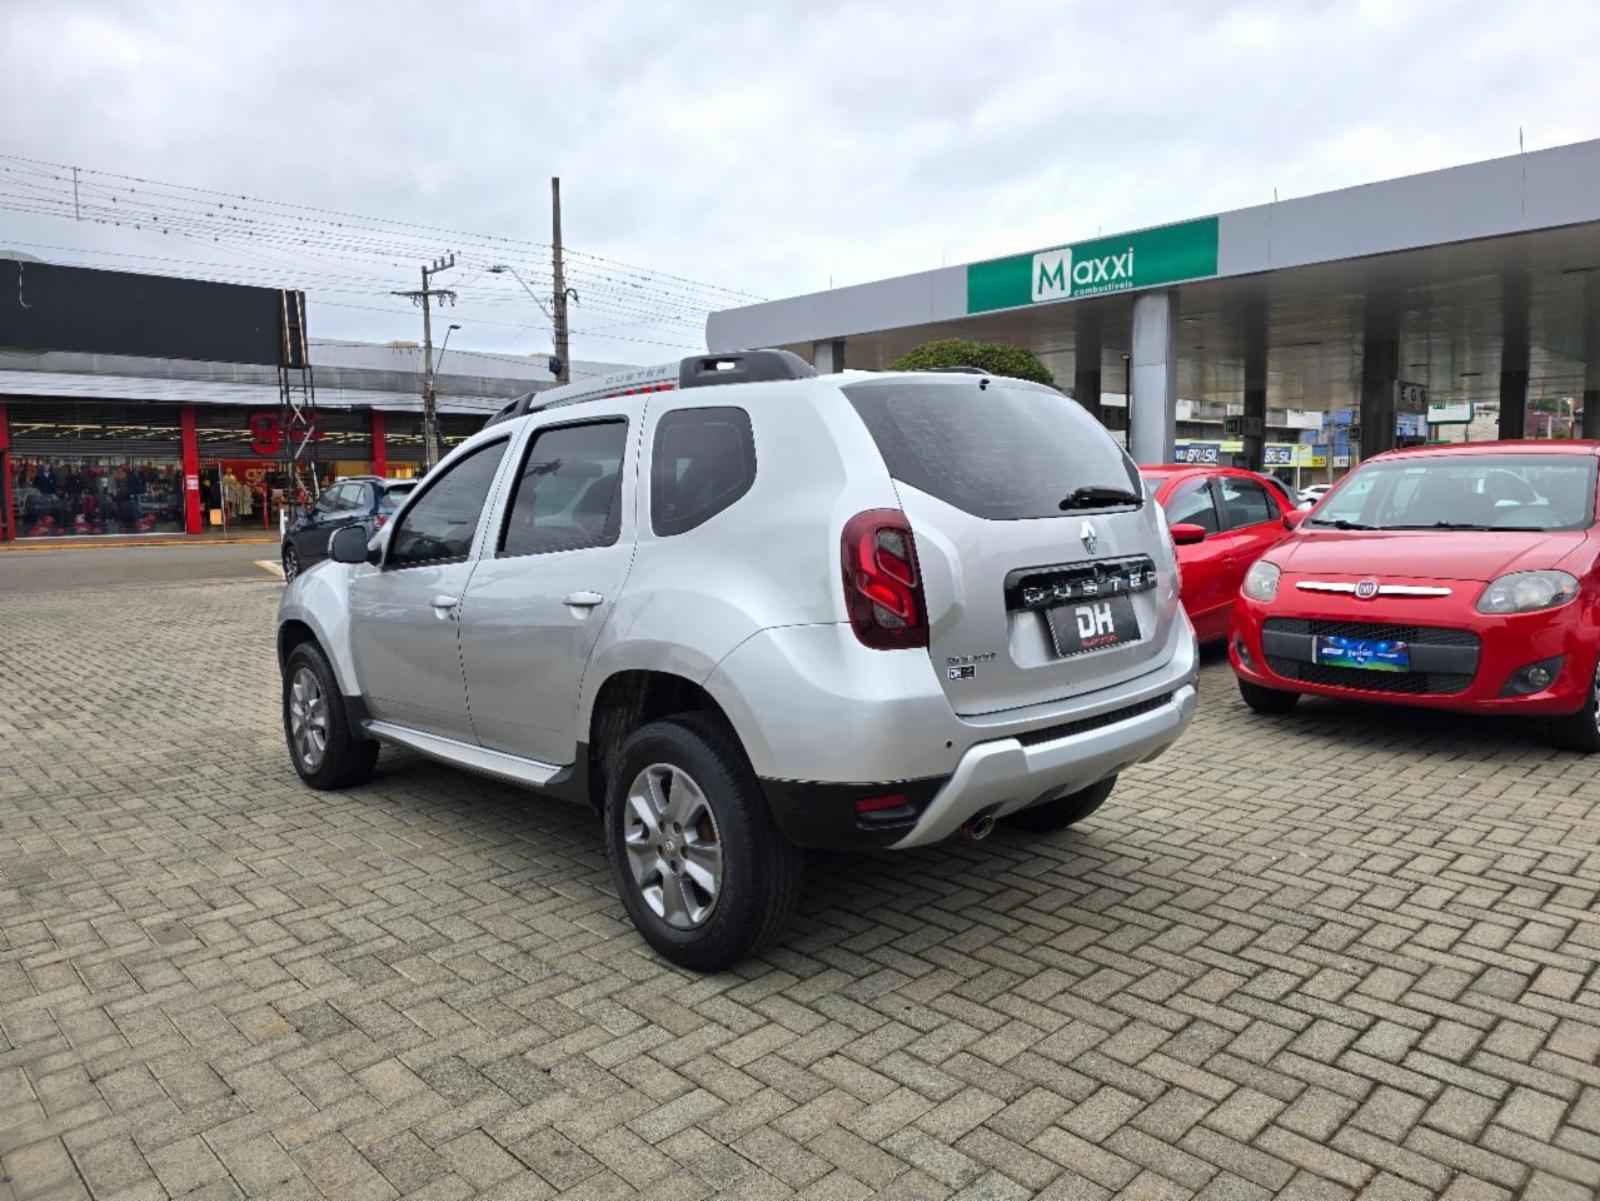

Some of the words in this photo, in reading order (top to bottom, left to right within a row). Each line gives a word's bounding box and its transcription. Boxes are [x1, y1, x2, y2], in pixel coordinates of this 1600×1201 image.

[1037, 247, 1134, 296] Maxxi
[606, 367, 666, 385] DUSTER
[1075, 602, 1114, 639] DH
